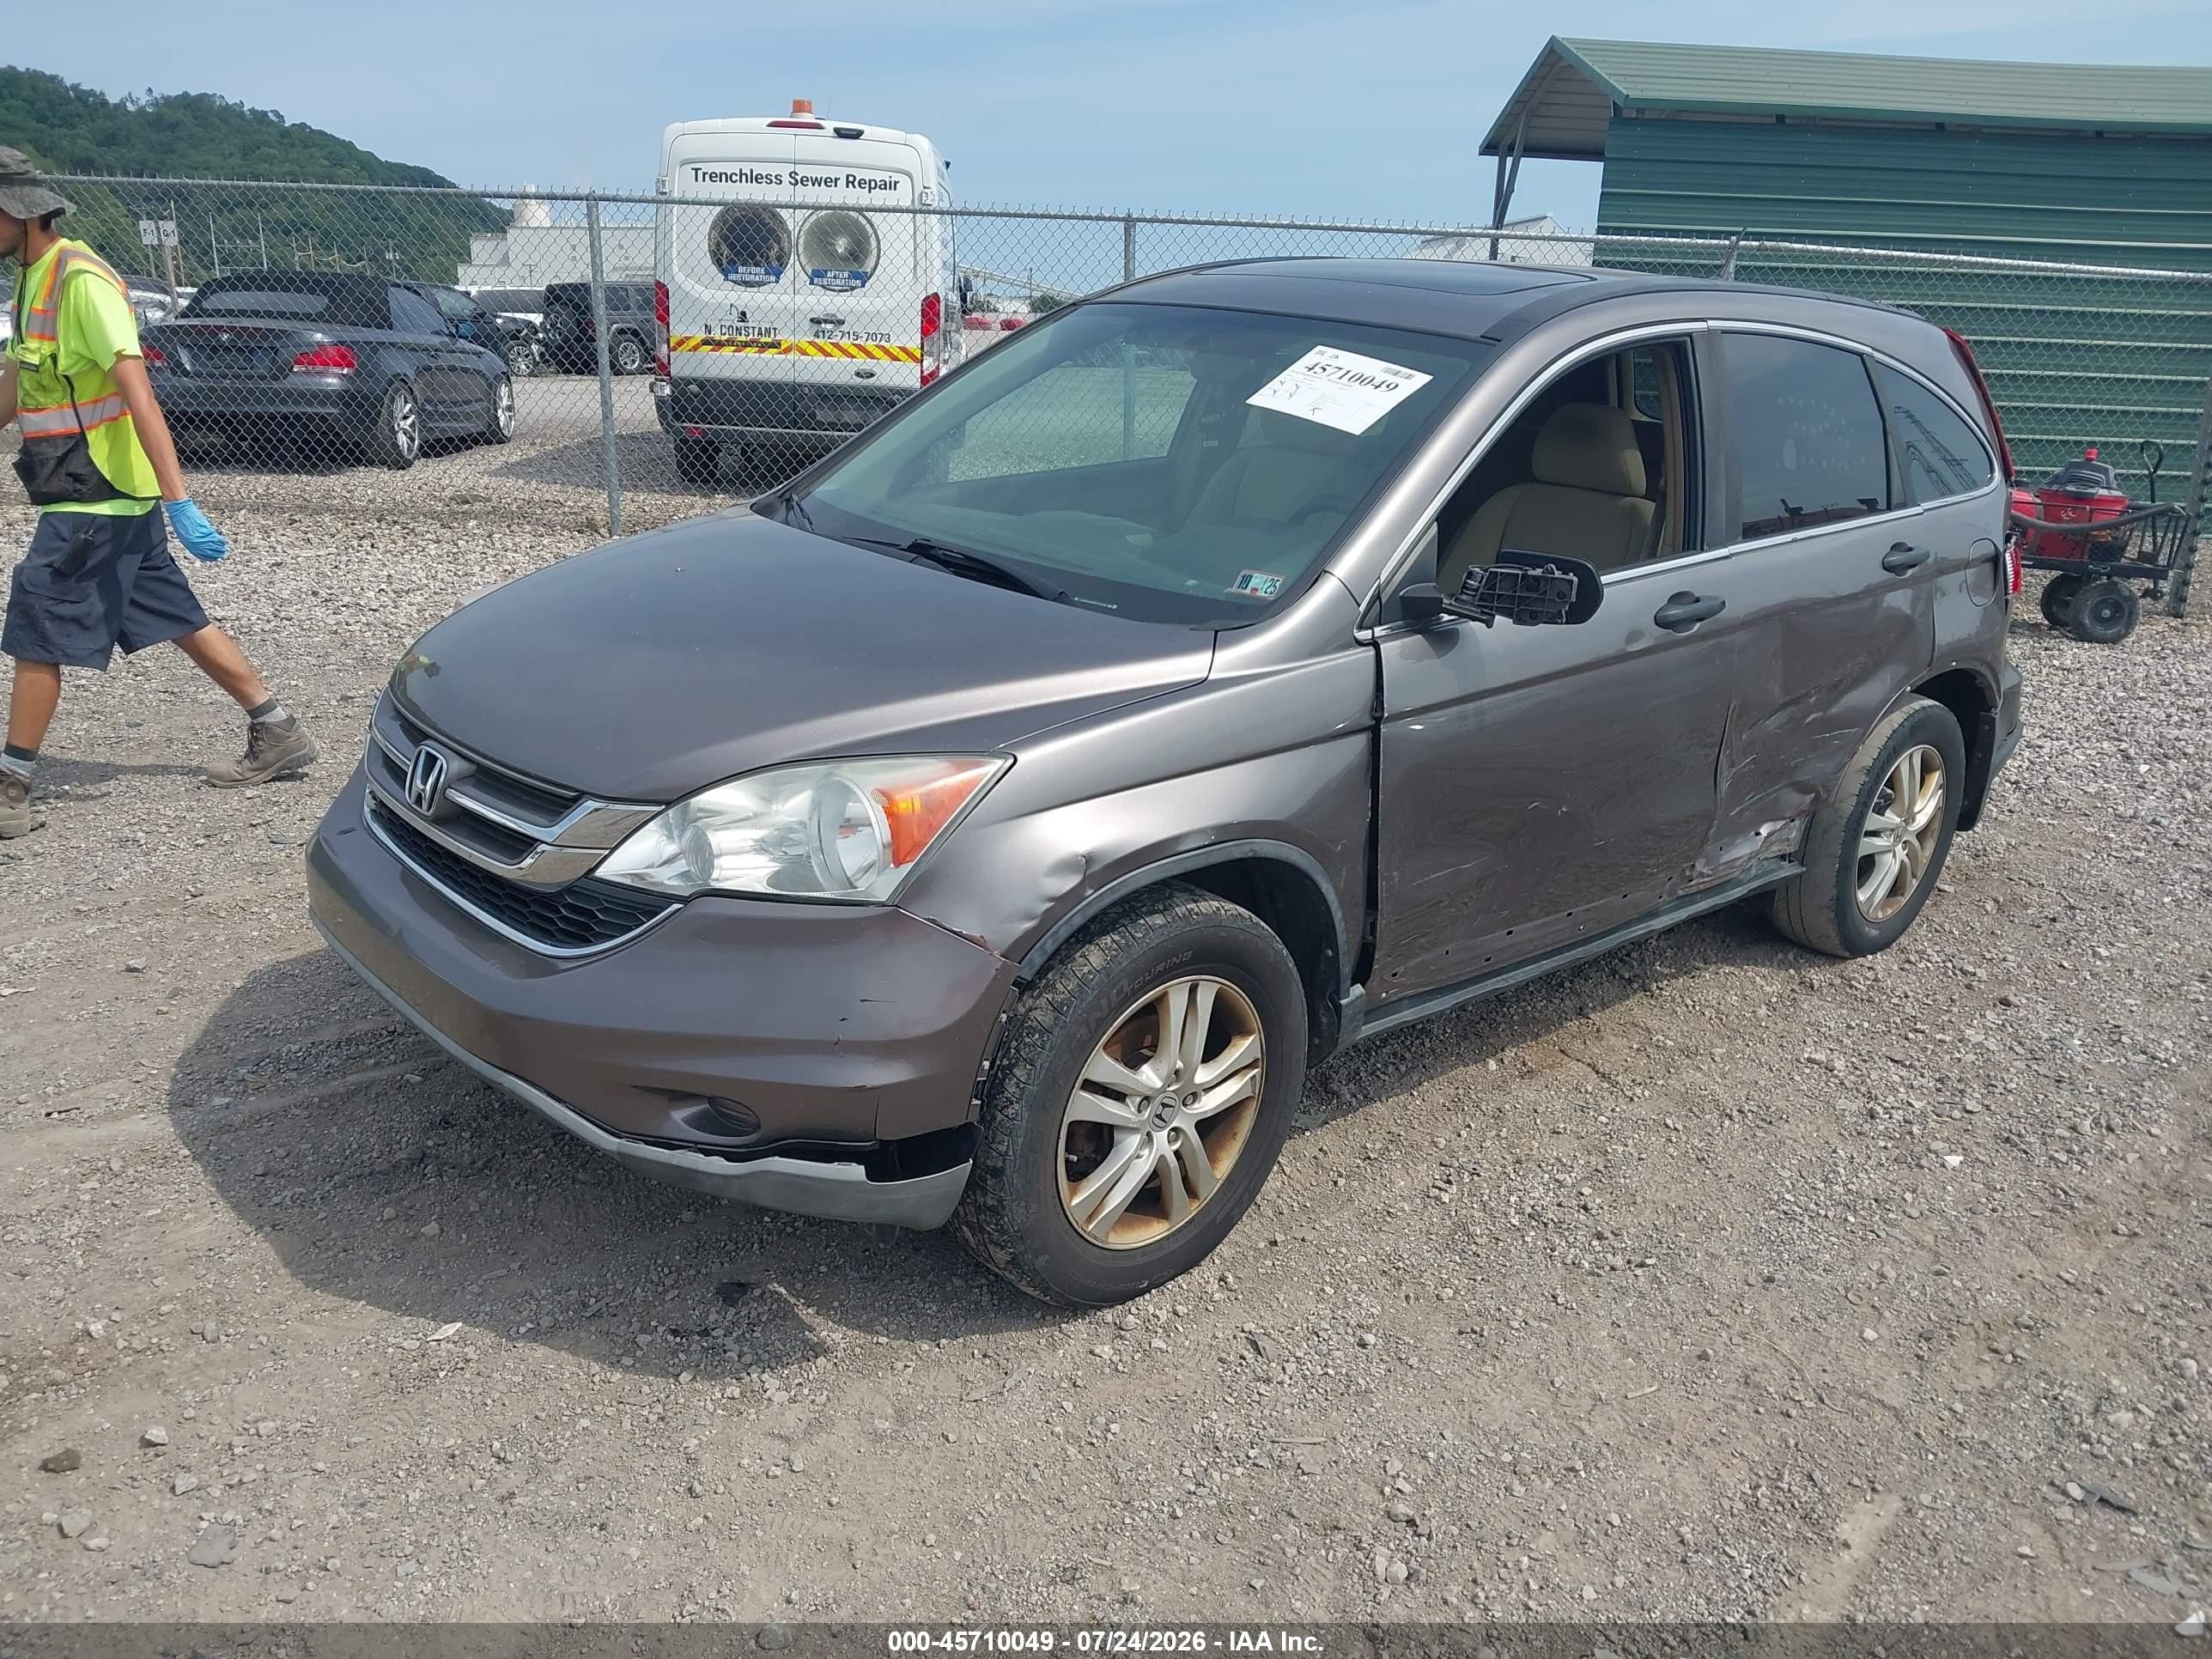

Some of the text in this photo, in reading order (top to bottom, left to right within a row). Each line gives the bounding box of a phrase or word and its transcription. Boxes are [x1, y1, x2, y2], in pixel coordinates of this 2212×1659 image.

[690, 167, 901, 194] Trenchless Sewer Repair
[738, 266, 766, 275] BEFORE
[826, 270, 849, 279] AFTER
[727, 272, 776, 283] RESTORATION
[813, 277, 862, 287] RESTORATION
[704, 323, 778, 338] N. CONSTANT
[813, 329, 891, 343] 412-715-7073
[1304, 361, 1400, 392] 45710049
